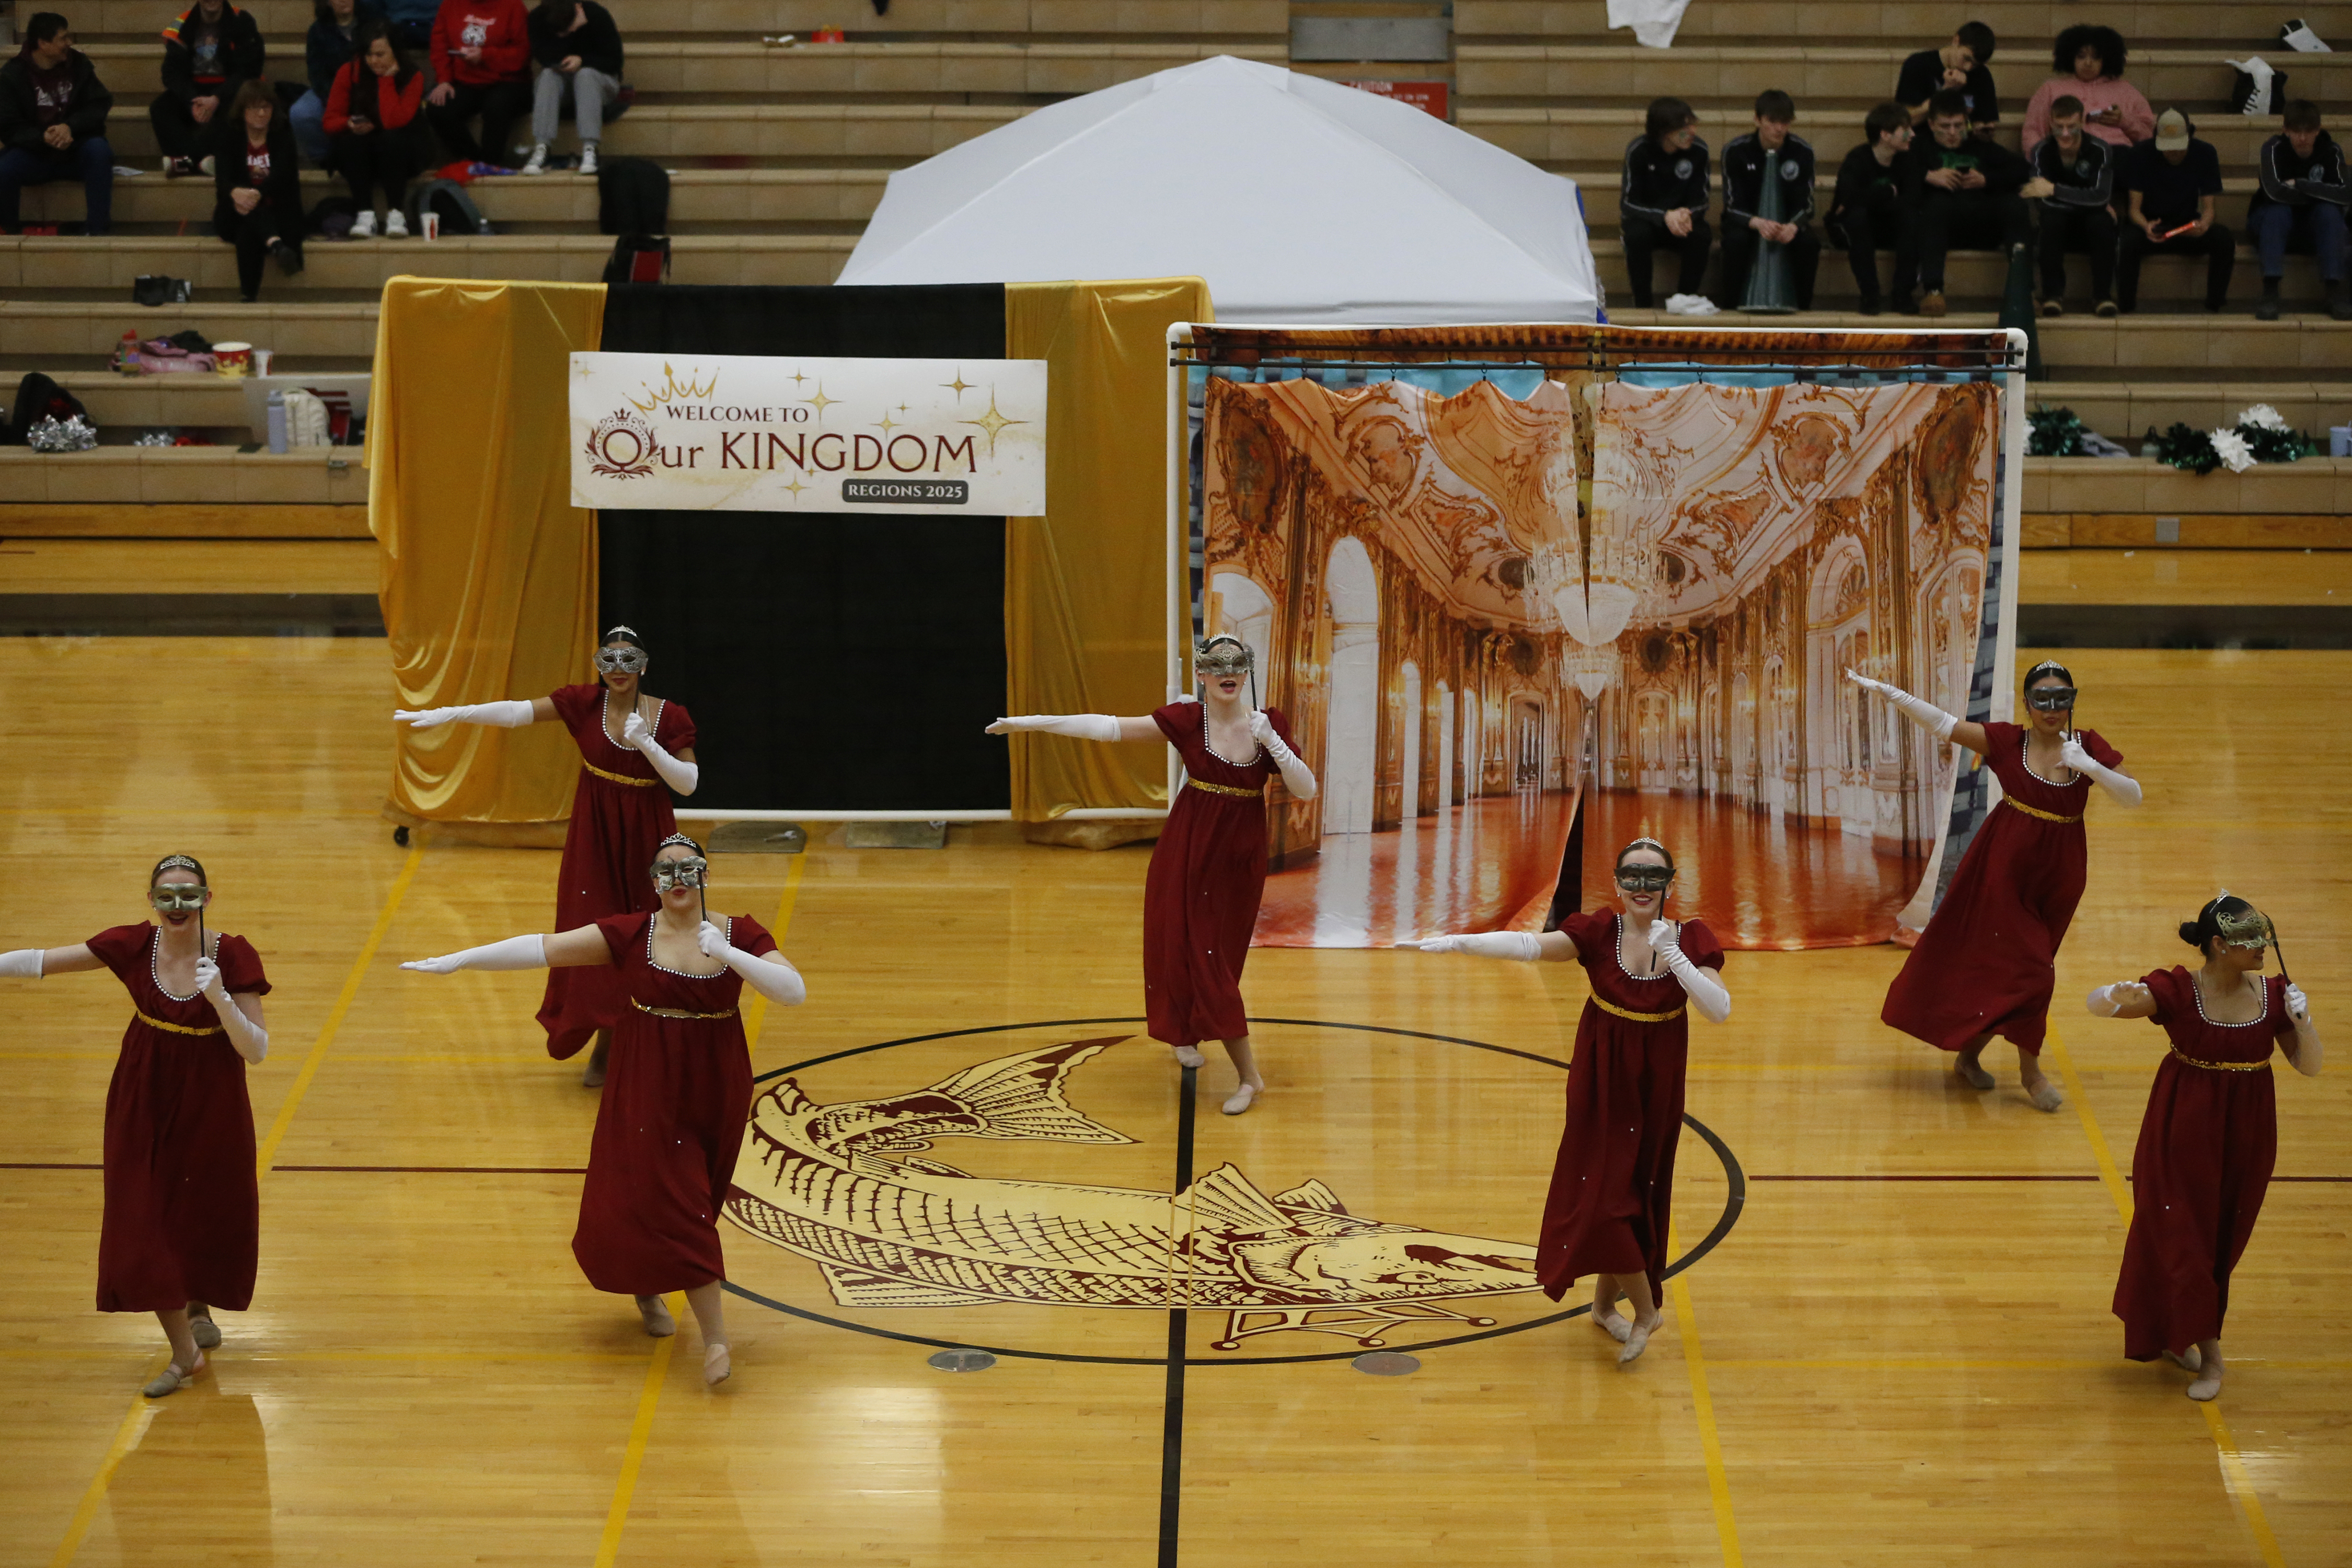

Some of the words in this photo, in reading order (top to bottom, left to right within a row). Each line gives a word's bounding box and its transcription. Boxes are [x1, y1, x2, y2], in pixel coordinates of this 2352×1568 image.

[666, 405, 773, 422] WELCOME
[779, 407, 809, 423] TO
[603, 429, 704, 468] Our
[721, 432, 977, 472] KINGDOM
[848, 485, 921, 497] REGIONS
[926, 486, 962, 498] 2025
